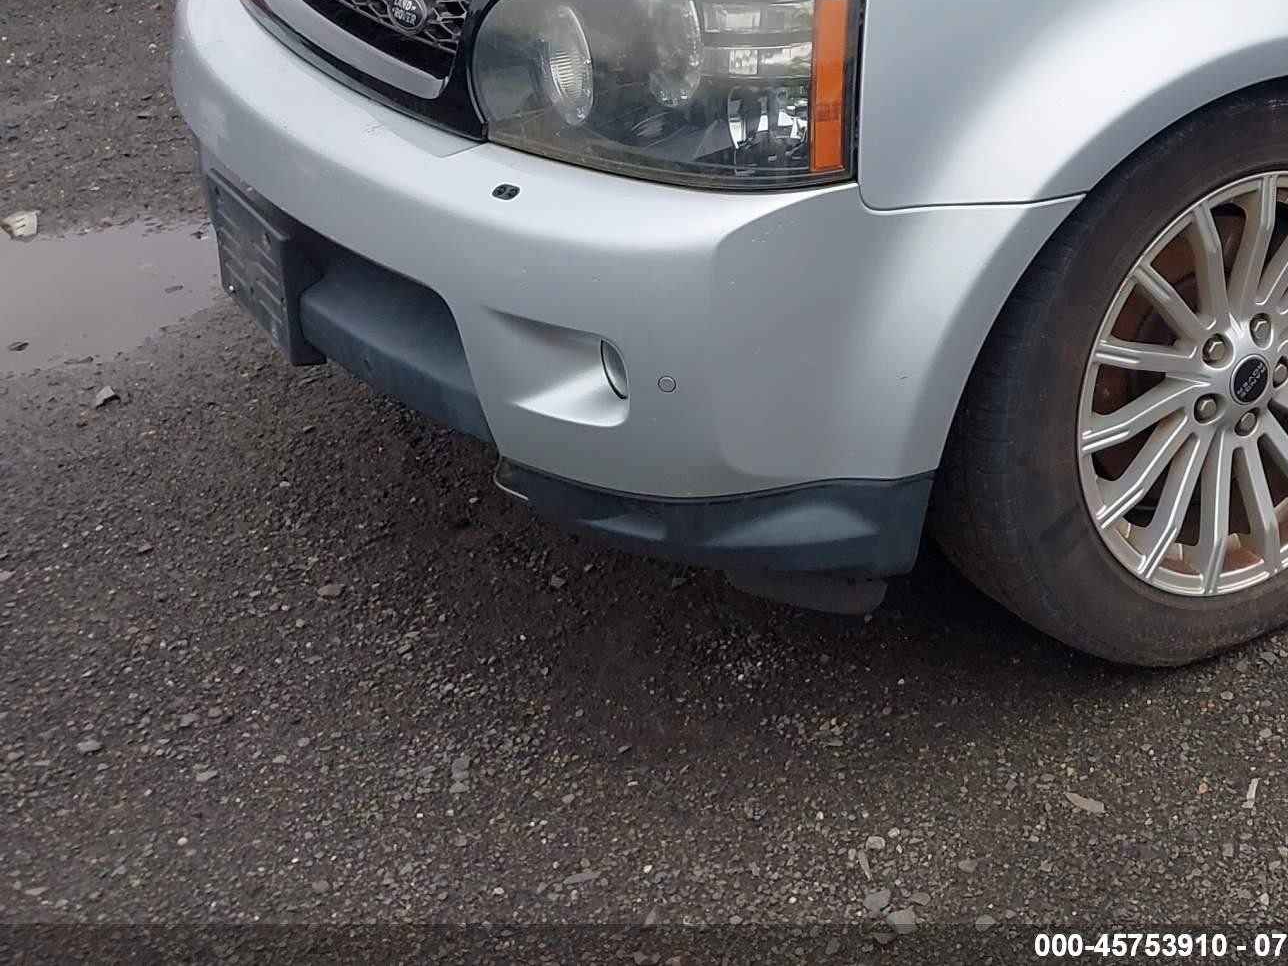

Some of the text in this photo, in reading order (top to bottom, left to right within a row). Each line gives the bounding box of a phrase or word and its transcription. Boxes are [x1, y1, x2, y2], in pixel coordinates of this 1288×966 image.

[393, 10, 417, 26] ROVER
[1236, 361, 1263, 395] ROVER
[1240, 366, 1266, 398] RANGE
